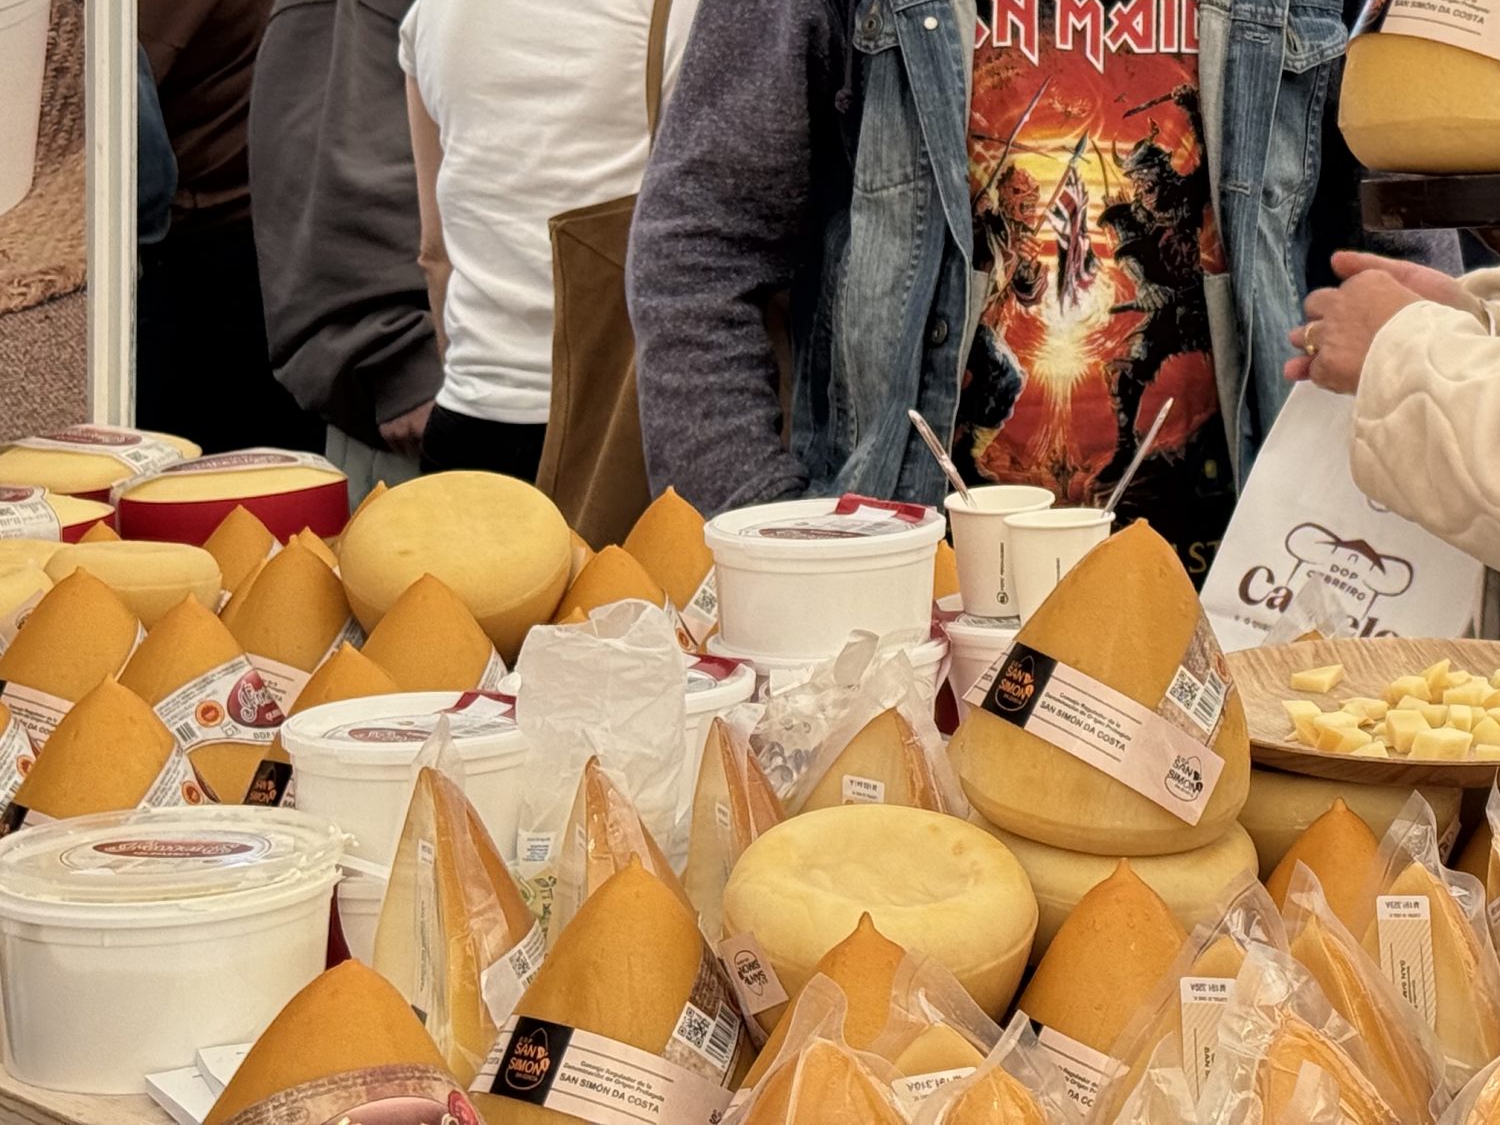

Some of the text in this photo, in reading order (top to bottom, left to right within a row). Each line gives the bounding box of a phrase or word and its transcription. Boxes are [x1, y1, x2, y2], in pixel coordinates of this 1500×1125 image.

[1394, 0, 1410, 8] SAN
[1437, 5, 1451, 15] DA
[1452, 8, 1485, 25] COSTA
[1329, 563, 1358, 579] DOP
[1307, 570, 1366, 601] CBREIRO
[1040, 700, 1126, 752] SAN SIMÓN DA COSTA
[1172, 758, 1194, 778] SAN
[514, 1043, 537, 1058] SAN
[559, 1072, 660, 1114] SAN SIMÓN DA COSTA
